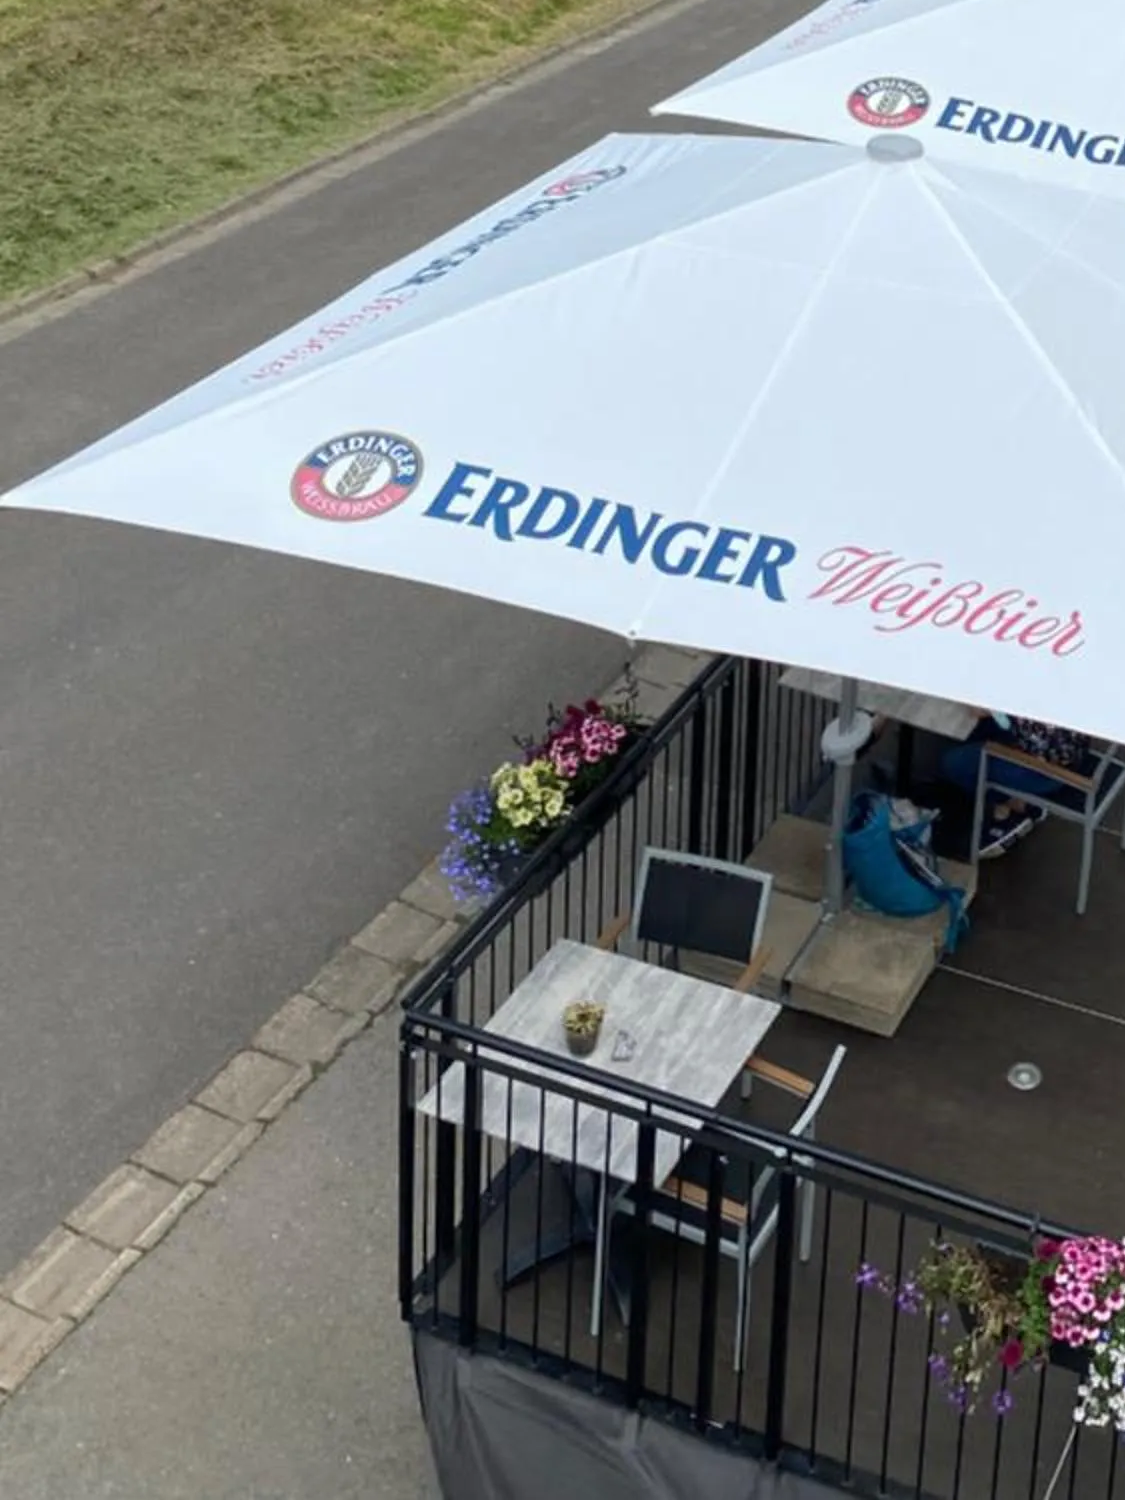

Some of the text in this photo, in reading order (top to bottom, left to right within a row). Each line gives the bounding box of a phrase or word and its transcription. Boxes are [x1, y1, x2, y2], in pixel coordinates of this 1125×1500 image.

[316, 435, 418, 478] ERDINGER
[422, 461, 1086, 657] ERDINGER Weißbier
